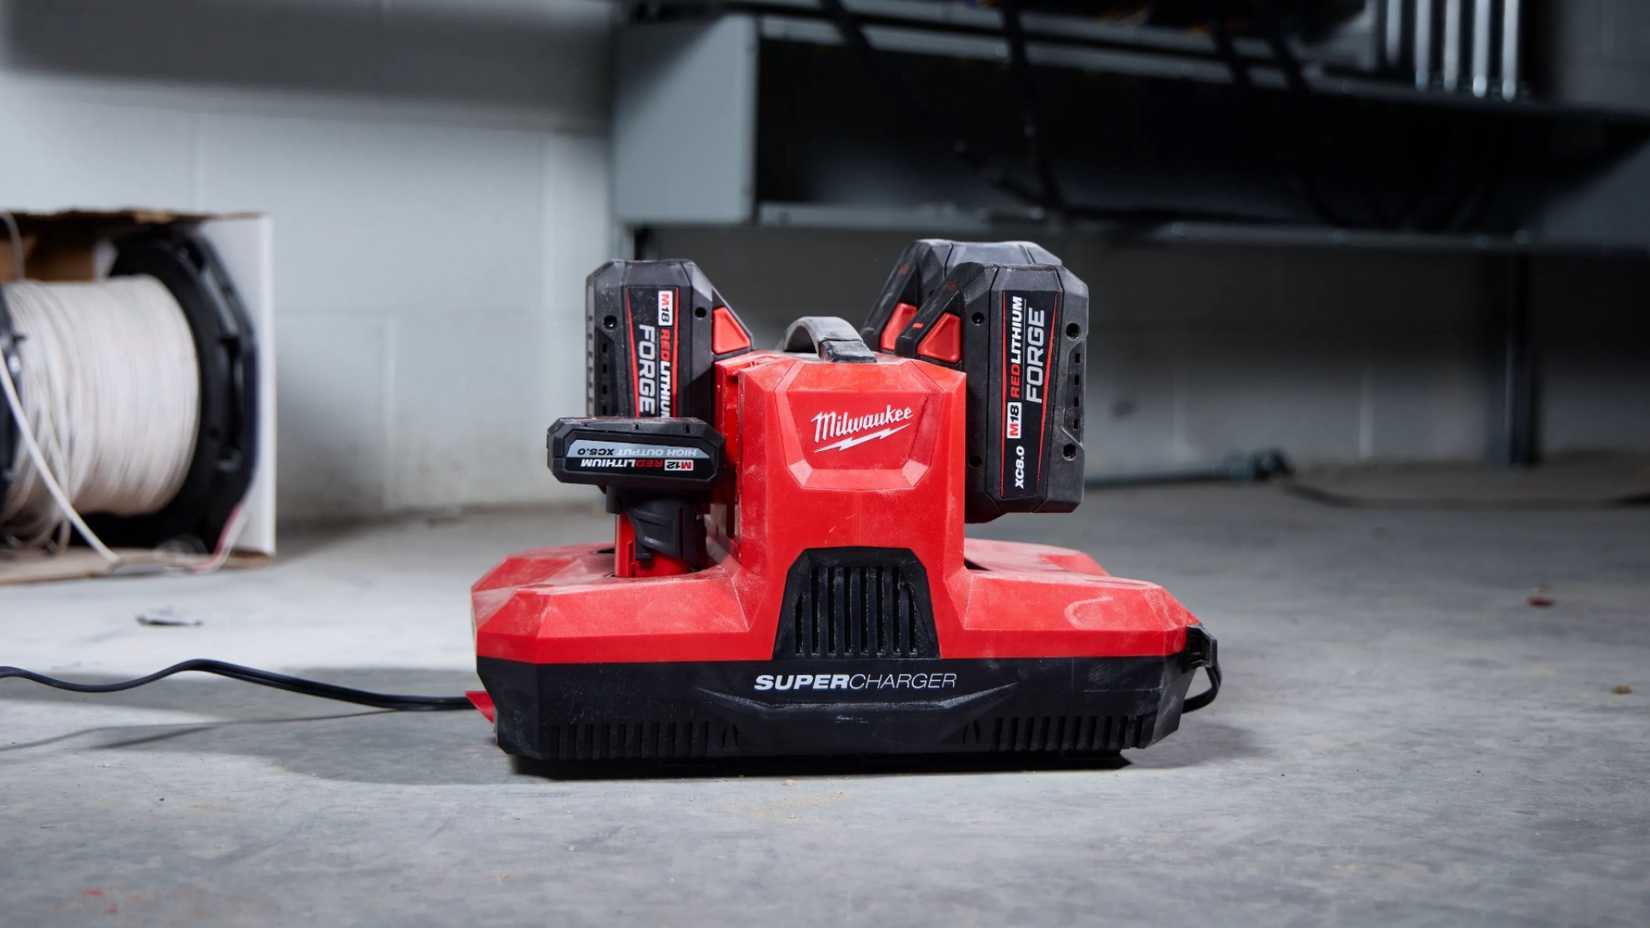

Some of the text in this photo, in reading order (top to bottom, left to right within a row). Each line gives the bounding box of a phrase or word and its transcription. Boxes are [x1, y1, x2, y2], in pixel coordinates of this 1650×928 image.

[660, 293, 671, 323] M18
[639, 324, 655, 414] FORGE
[1008, 296, 1023, 437] M18 REDLITHIUM
[1026, 308, 1045, 404] FORGE
[811, 404, 913, 443] Milwaukee
[576, 447, 697, 457] HIGH OUTPUT XC5.0
[580, 458, 692, 470] M12 REDLITHIUM
[1014, 446, 1025, 489] XC8.0
[754, 673, 957, 691] SUPERCHARGER
